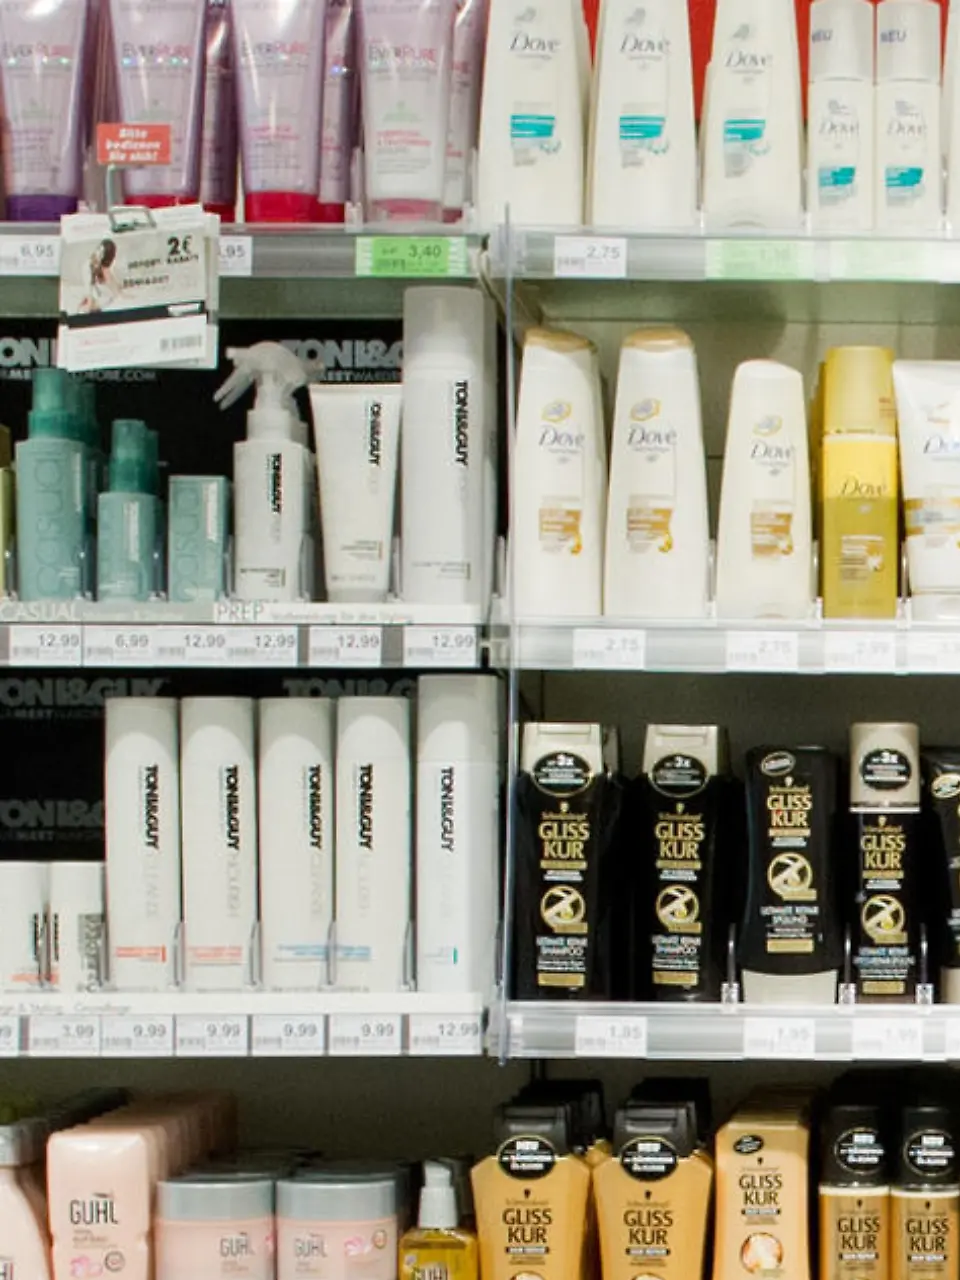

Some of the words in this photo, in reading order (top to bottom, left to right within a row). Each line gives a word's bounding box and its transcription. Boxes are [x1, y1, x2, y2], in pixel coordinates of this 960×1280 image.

[510, 34, 560, 53] Dove
[621, 34, 671, 54] Dove
[725, 51, 772, 67] Dove
[539, 428, 585, 447] Dove
[628, 428, 677, 447] Dove
[841, 477, 887, 497] Dove
[767, 795, 812, 811] GLISS
[772, 811, 807, 827] KUR
[539, 822, 590, 840] GLISS
[655, 822, 705, 840] GLISS
[543, 842, 584, 859] KUR
[660, 842, 699, 859] KUR
[861, 835, 905, 851] GLISS
[865, 852, 902, 869] KUR
[739, 1174, 783, 1190] GLISS
[743, 1190, 779, 1206] KUR
[70, 1199, 118, 1224] GUHL
[502, 1209, 552, 1225] GLISS
[623, 1211, 673, 1227] GLISS
[837, 1216, 881, 1233] GLISS
[906, 1218, 949, 1235] GLISS
[508, 1227, 547, 1244] KUR
[629, 1228, 668, 1245] KUR
[841, 1234, 877, 1250] KUR
[909, 1235, 946, 1251] KUR
[220, 1236, 255, 1257] GUHL
[295, 1237, 327, 1258] GUHL
